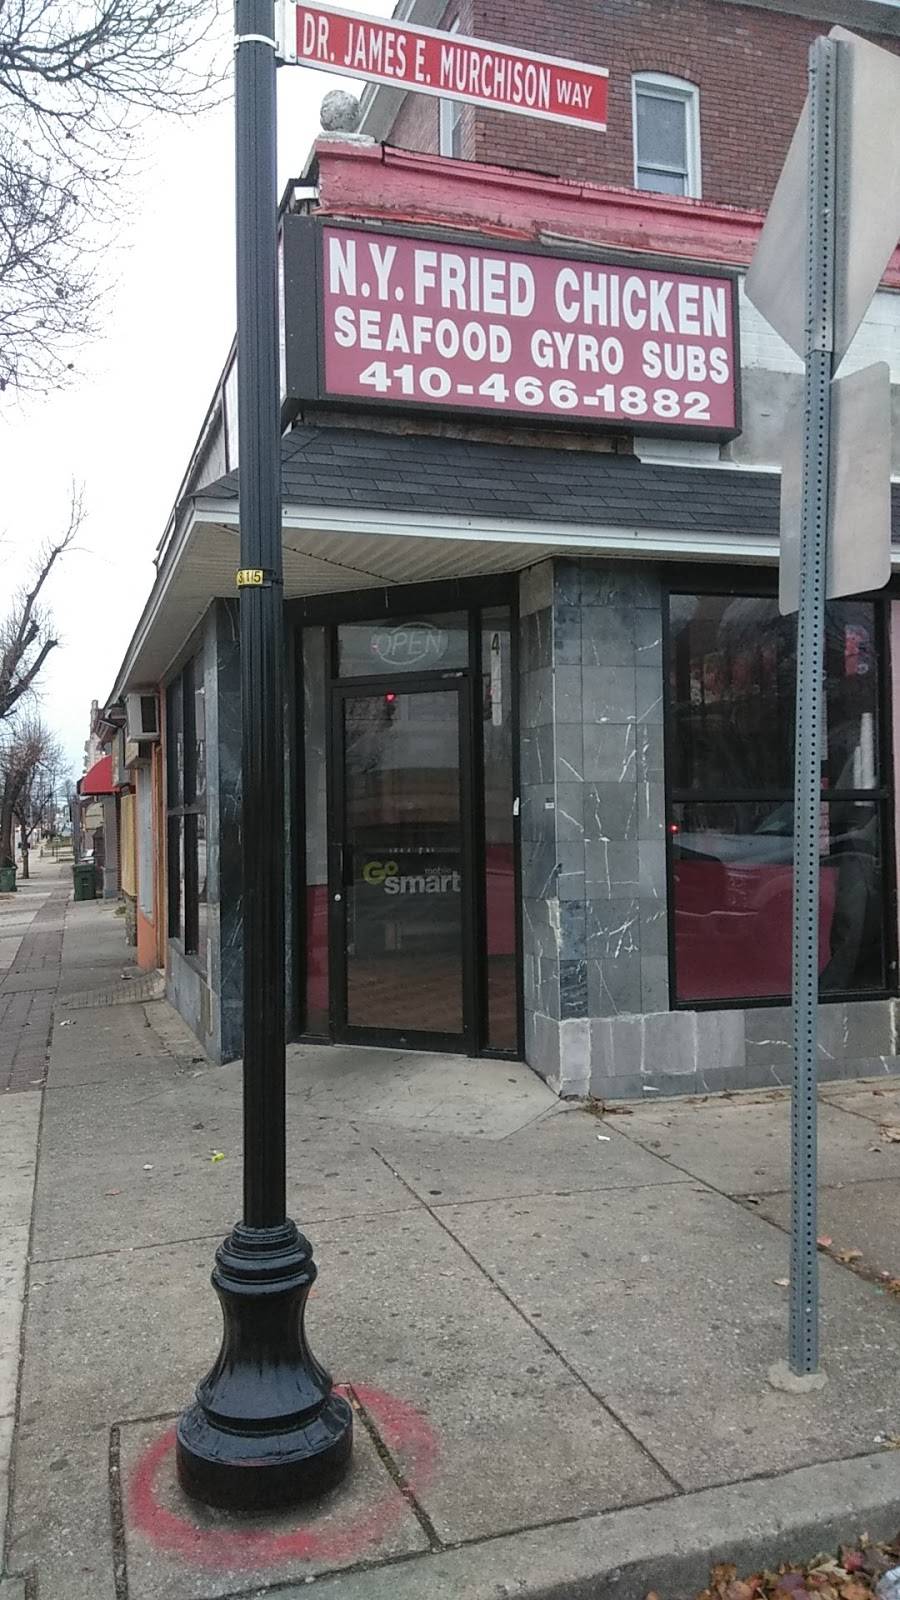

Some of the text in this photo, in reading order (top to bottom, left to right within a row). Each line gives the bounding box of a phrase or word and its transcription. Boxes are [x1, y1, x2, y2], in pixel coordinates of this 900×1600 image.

[303, 13, 594, 110] DR. JAMES E. MURCHISON WAY
[328, 237, 727, 337] N.Y. FRIED CHICKEN
[333, 306, 729, 384] SEAFOOD GYRO SUBS
[359, 361, 711, 420] 410-466-1882
[239, 571, 261, 583] 315
[371, 630, 442, 656] OPEN
[362, 860, 462, 894] Go smart
